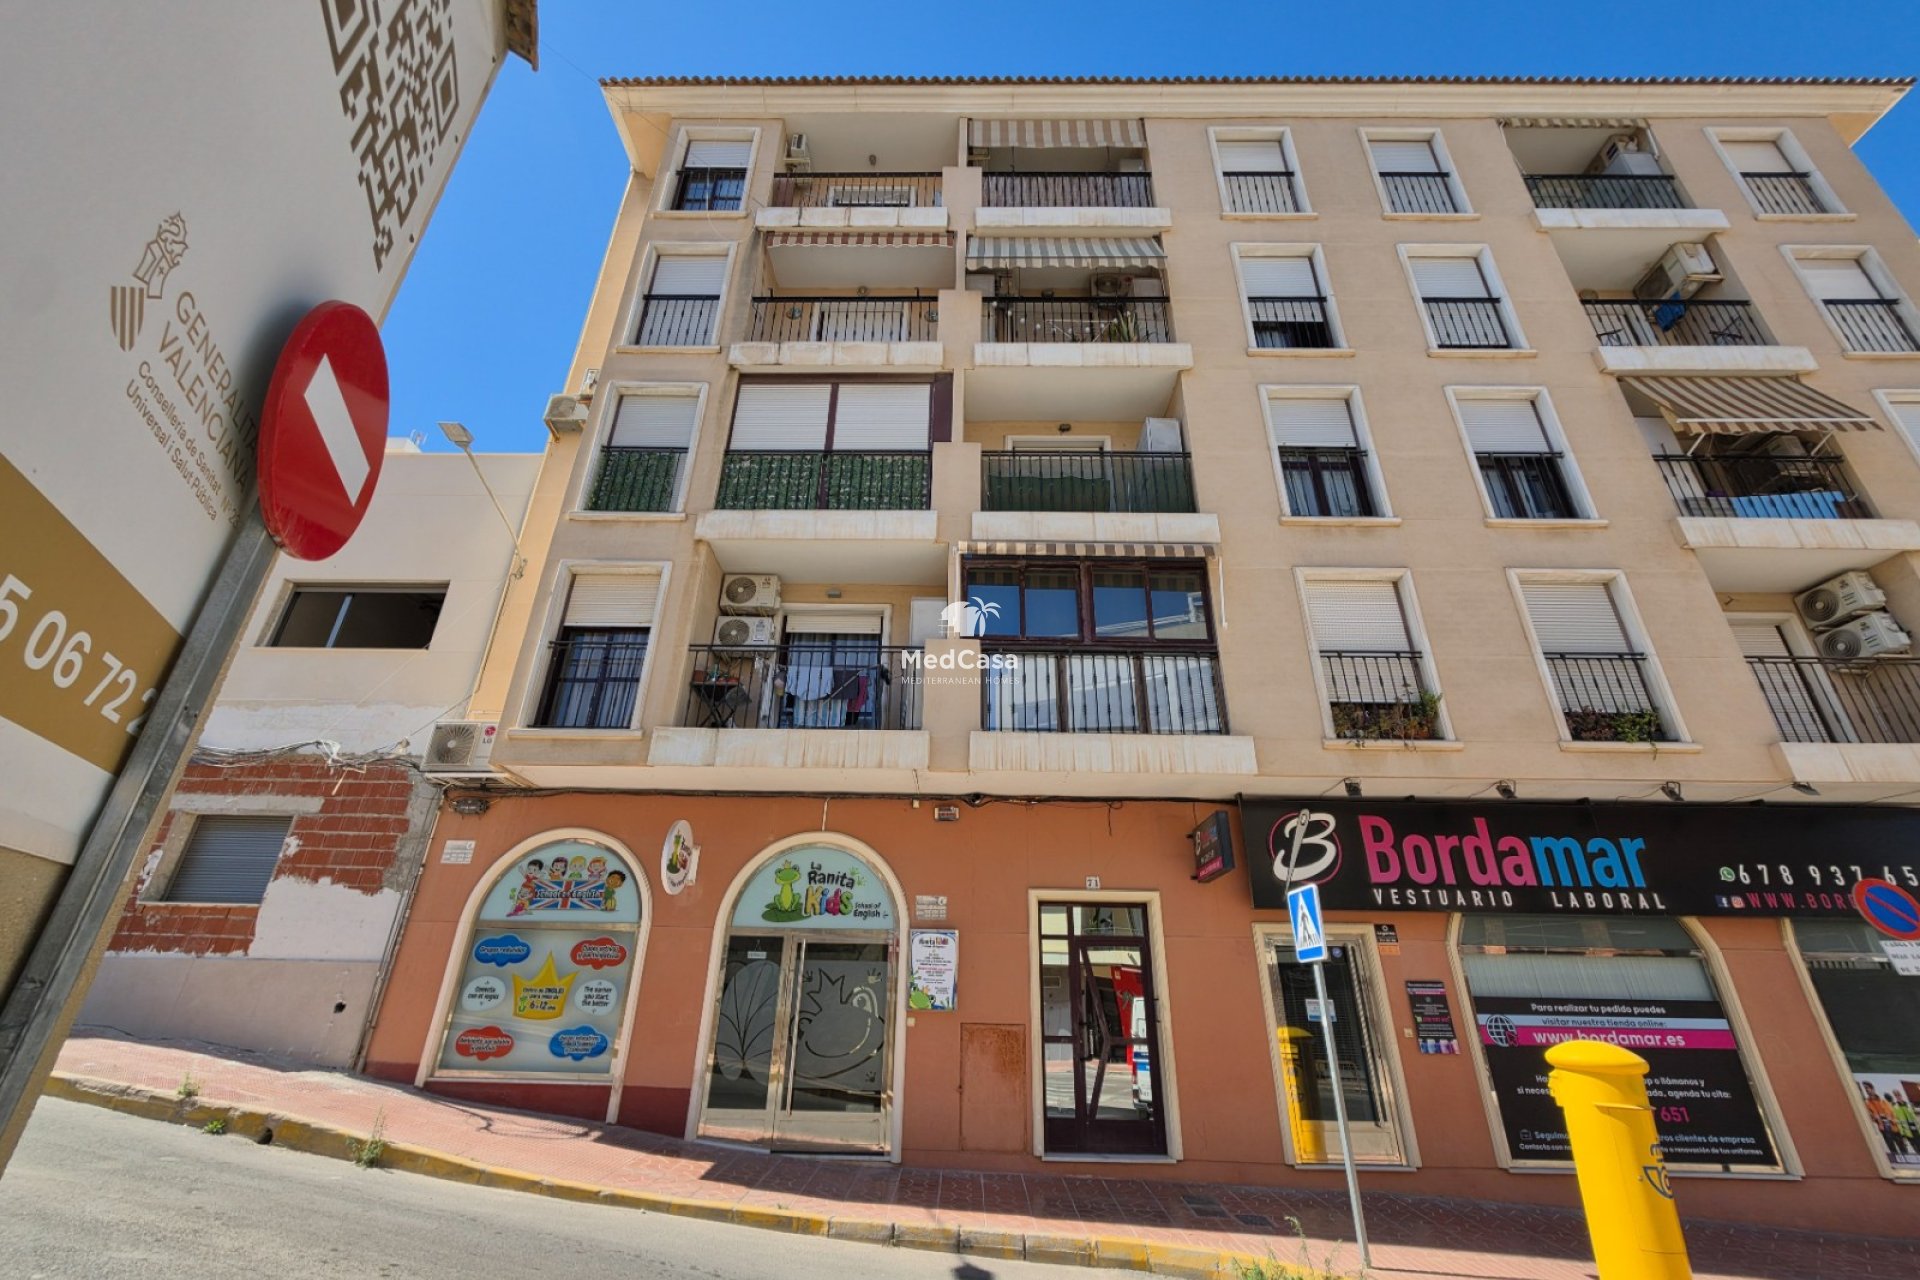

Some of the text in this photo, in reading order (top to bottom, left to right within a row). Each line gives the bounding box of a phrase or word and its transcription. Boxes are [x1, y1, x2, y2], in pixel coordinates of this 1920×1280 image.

[176, 291, 258, 465] GENERALITA
[159, 321, 247, 494] VALENCIANA
[139, 361, 221, 496] Conselleria de Sanitat
[126, 379, 217, 521] Universal i Salut Pública
[24, 610, 92, 688] 06
[84, 652, 137, 724] 72
[1358, 815, 1647, 887] Bordamar
[811, 862, 821, 870] La
[1739, 864, 1794, 885] 678
[808, 872, 855, 889] Ranita
[804, 886, 853, 915] Kids
[1372, 888, 1667, 910] VESTUARIO LABORAL
[853, 909, 880, 920] English
[1530, 1003, 1666, 1015] Para realizar tu pedido puedes
[1542, 1017, 1667, 1028] visitar nuestra tienda online:
[1532, 1030, 1686, 1046] wwwbordamar.es
[1699, 1079, 1705, 1087] y
[1517, 1086, 1524, 1095] si
[1525, 1087, 1550, 1095] neces
[1668, 1090, 1700, 1099] agenda
[1701, 1090, 1710, 1098] tu
[1711, 1090, 1732, 1098] cita:
[1661, 1106, 1690, 1122] 651
[1674, 1134, 1707, 1142] clientes
[1719, 1136, 1756, 1144] empresa
